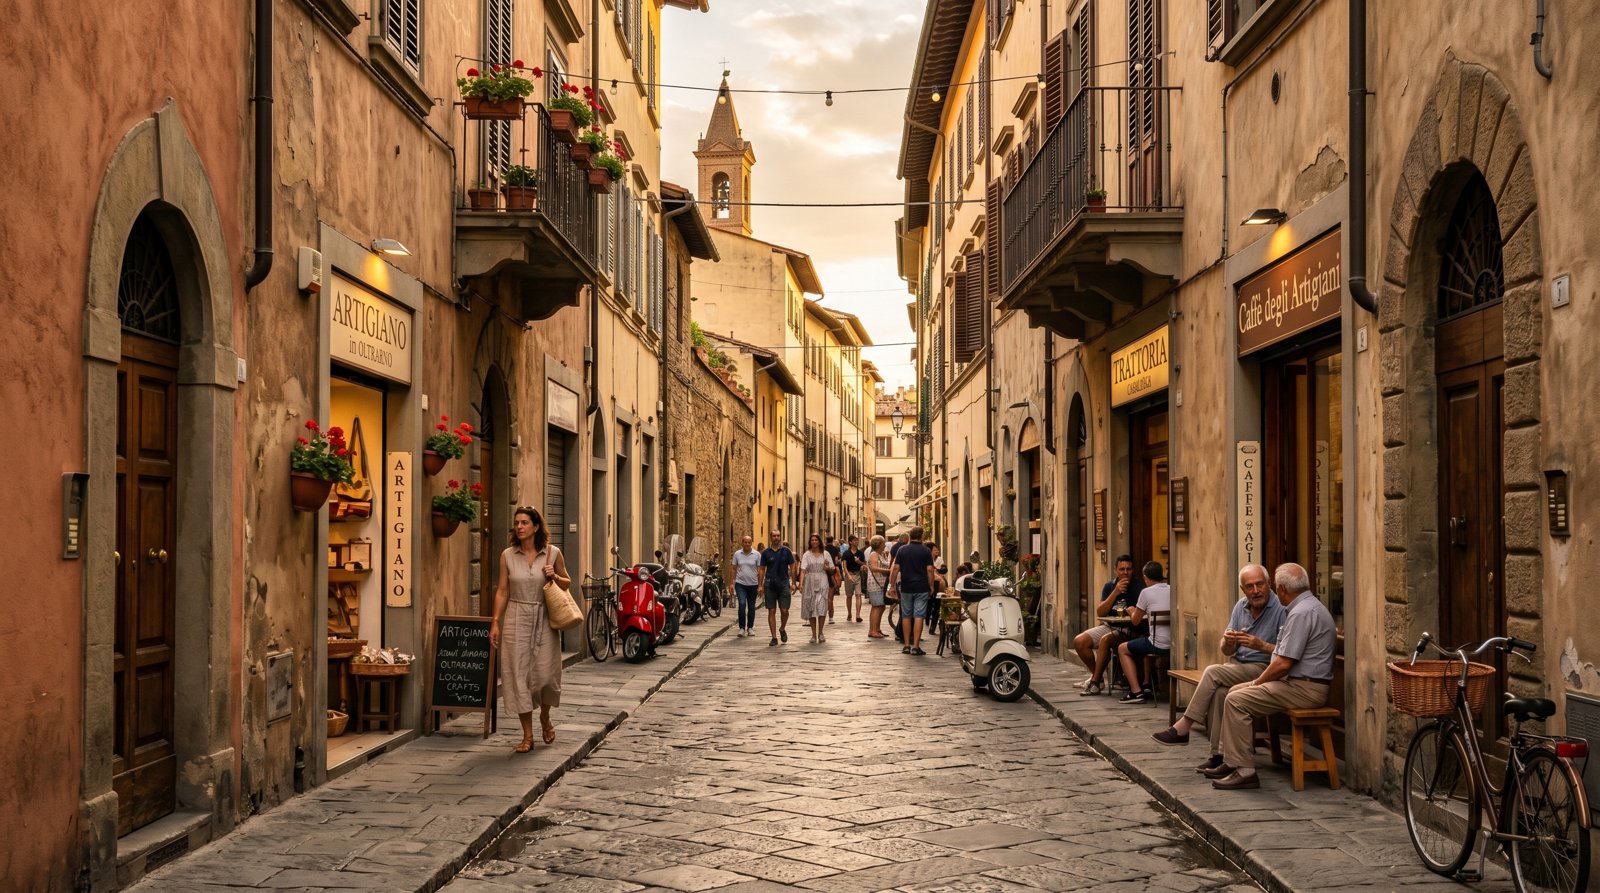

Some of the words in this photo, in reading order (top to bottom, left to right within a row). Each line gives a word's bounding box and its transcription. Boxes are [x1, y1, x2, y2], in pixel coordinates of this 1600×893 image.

[1264, 280, 1289, 328] degli
[1290, 251, 1341, 312] Artigiani
[332, 290, 407, 350] ARTIGIANO
[349, 334, 357, 354] in
[358, 340, 393, 368] OLTRARNO
[1113, 335, 1168, 385] TRATTORIA
[393, 459, 405, 597] ARTIGIANO
[440, 625, 490, 638] ARTIGIANO
[438, 673, 470, 682] LOCAL
[446, 682, 481, 692] CRAFTS
